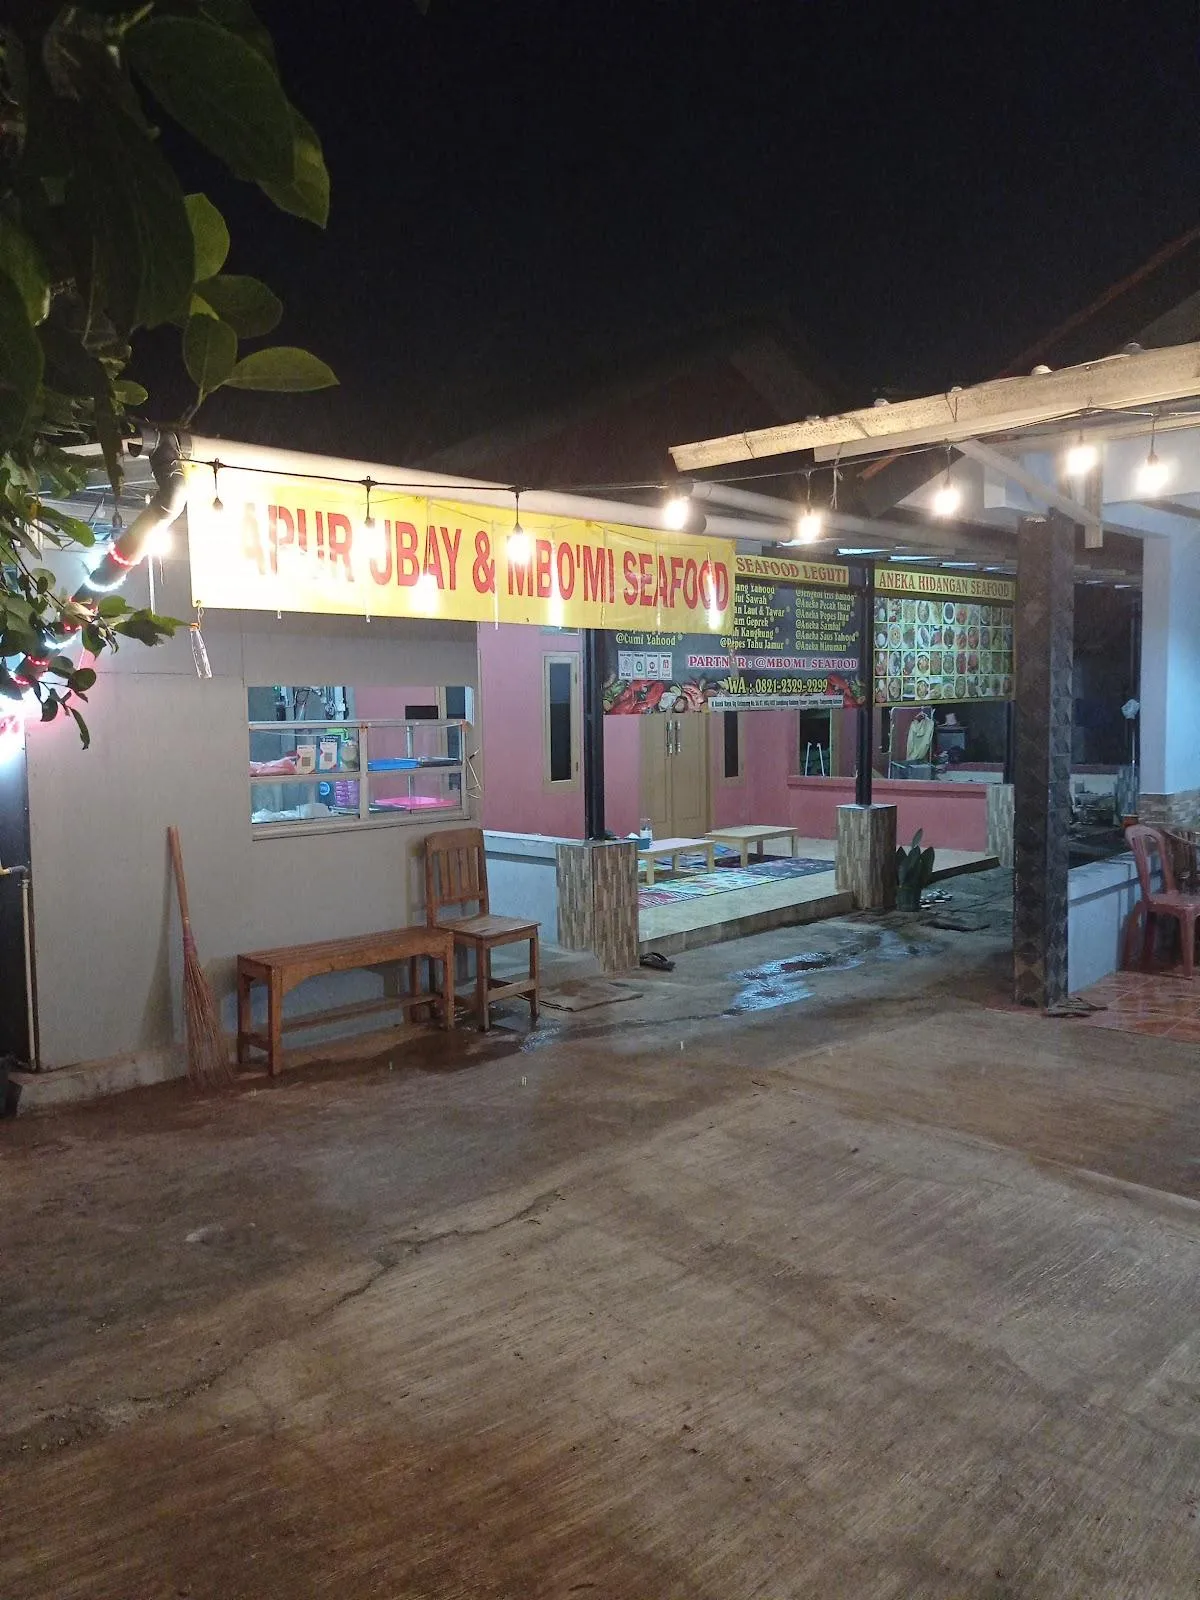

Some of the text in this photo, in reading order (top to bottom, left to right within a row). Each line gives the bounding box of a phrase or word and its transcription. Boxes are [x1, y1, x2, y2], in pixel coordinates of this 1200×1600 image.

[472, 530, 496, 594] &
[507, 535, 615, 604] MBO'MI
[623, 550, 729, 612] SEAFOOD
[736, 557, 800, 577] SEAFOOD
[879, 571, 1009, 597] ANEKA HIDANGAN SEAFOOD
[745, 594, 767, 605] Sawah
[743, 605, 758, 615] Laut
[758, 606, 765, 615] &
[765, 606, 785, 617] Tawar
[746, 616, 769, 628] Geprek
[615, 632, 676, 646] @Cumi Yahood
[746, 638, 763, 650] Tahu
[764, 639, 784, 650] Jamur
[688, 655, 747, 669] PARTNR
[727, 676, 747, 694] WA
[755, 678, 829, 694] 0821-2329-2299
